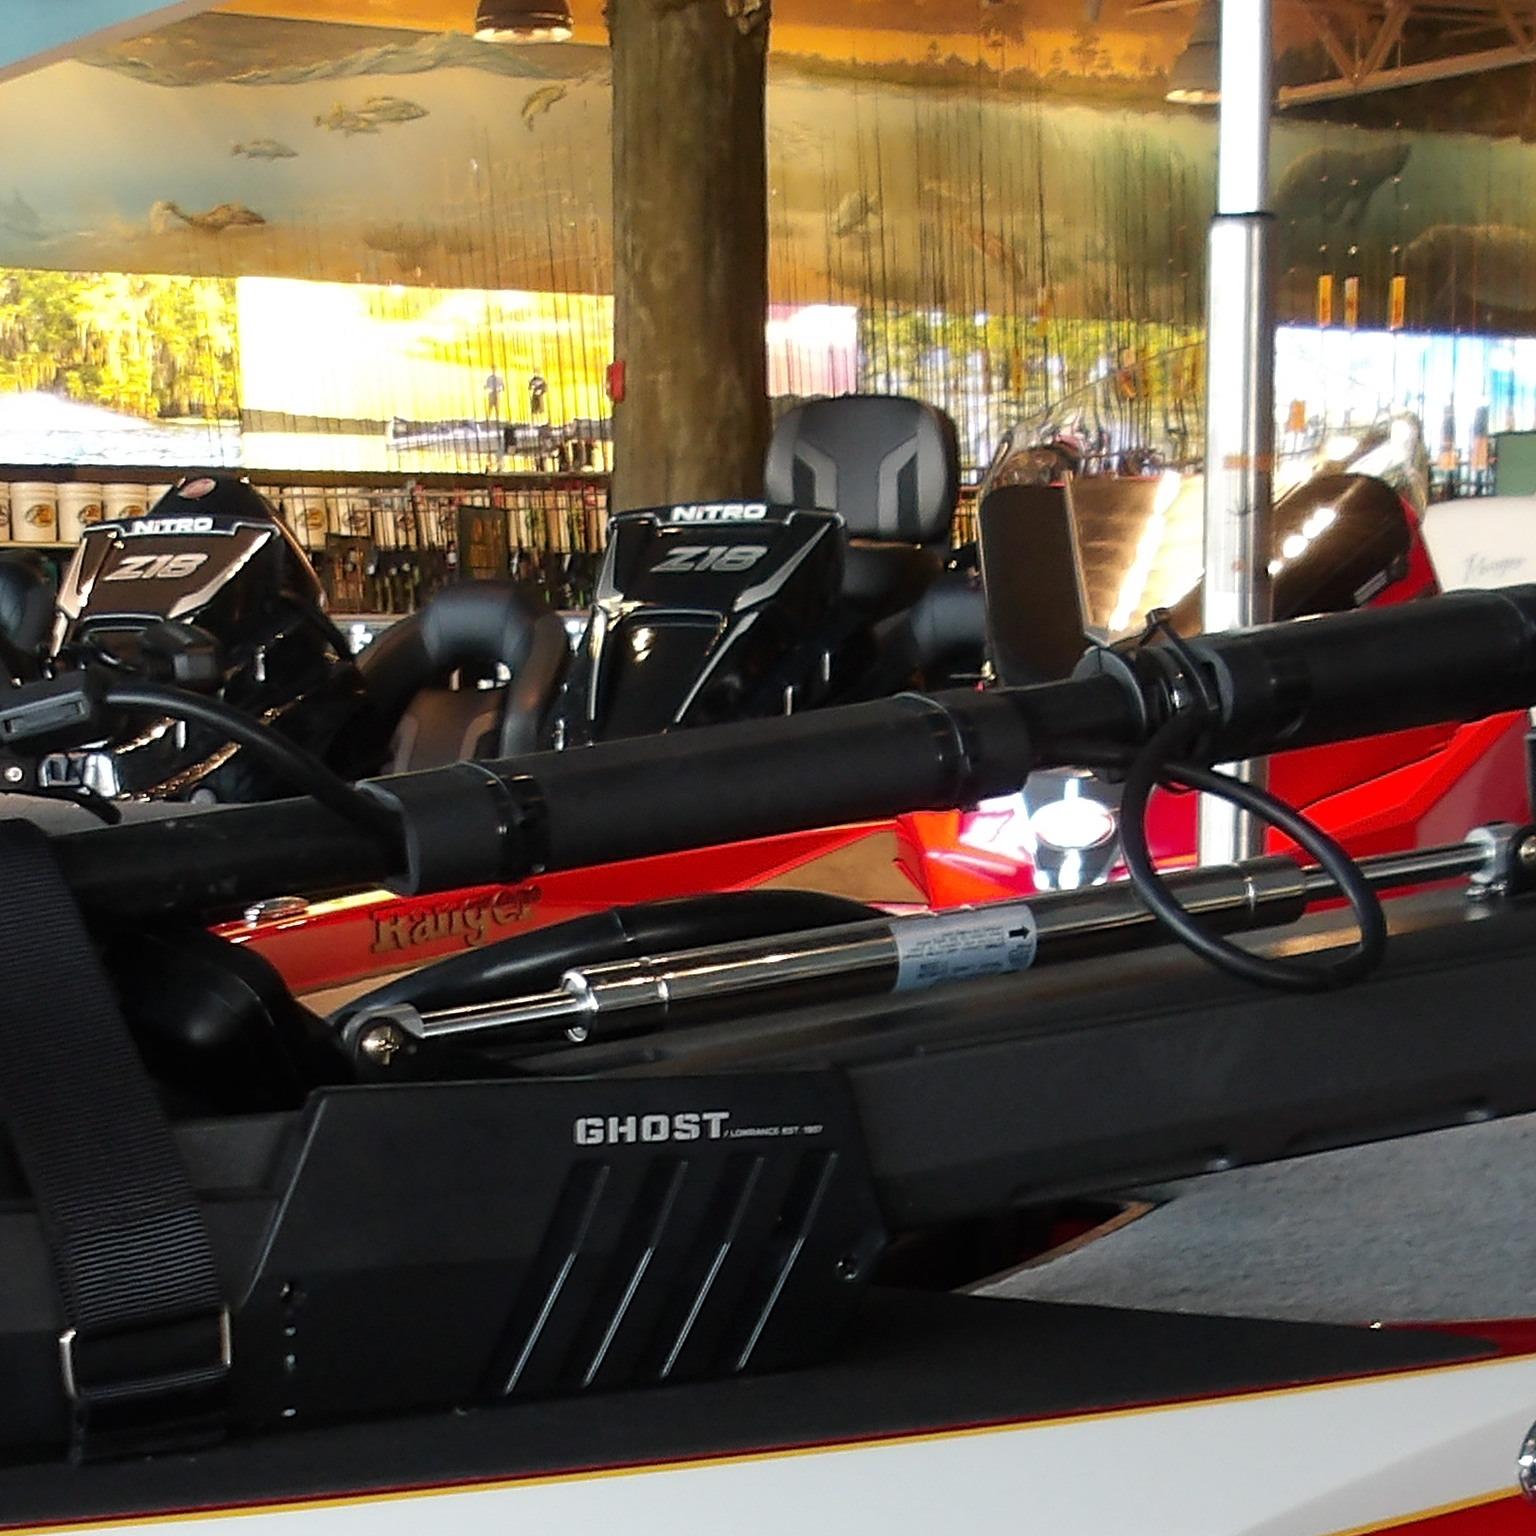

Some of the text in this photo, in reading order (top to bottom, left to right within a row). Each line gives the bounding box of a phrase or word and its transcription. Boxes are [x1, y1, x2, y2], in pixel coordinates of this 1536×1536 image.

[103, 553, 210, 581] Z18
[648, 545, 770, 572] Z18
[369, 885, 542, 954] Ranger
[575, 1112, 731, 1145] GHOST
